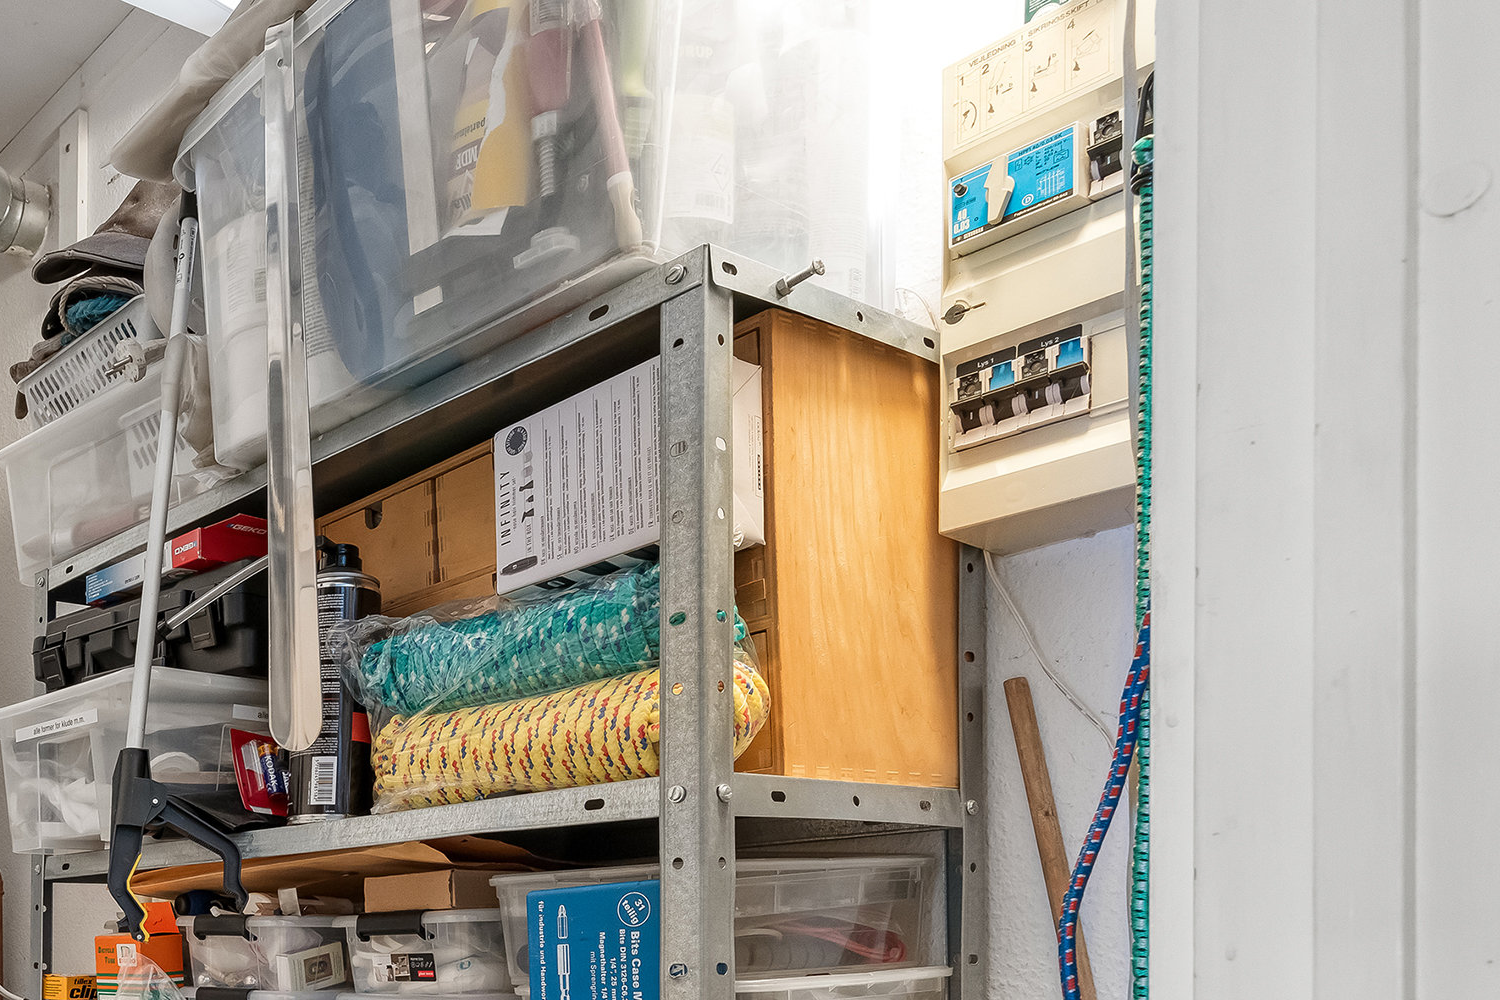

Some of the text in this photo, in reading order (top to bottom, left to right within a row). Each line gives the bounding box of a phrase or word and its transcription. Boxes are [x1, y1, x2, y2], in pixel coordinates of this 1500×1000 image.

[1067, 18, 1076, 30] 4
[1024, 40, 1034, 52] 3
[981, 63, 990, 75] 2
[960, 76, 964, 86] 1
[957, 208, 967, 220] 40
[954, 219, 970, 234] 0.03
[1041, 339, 1053, 348] Lys
[977, 361, 989, 369] Lys
[500, 470, 511, 546] INFINITY
[233, 523, 267, 535] GEKO
[174, 542, 194, 556] GEKO
[33, 726, 41, 736] alle
[41, 723, 54, 734] former
[264, 755, 278, 790] KODAK
[634, 898, 646, 911] 31
[630, 931, 640, 956] Bits
[631, 958, 641, 989] Case
[610, 976, 617, 987] 25
